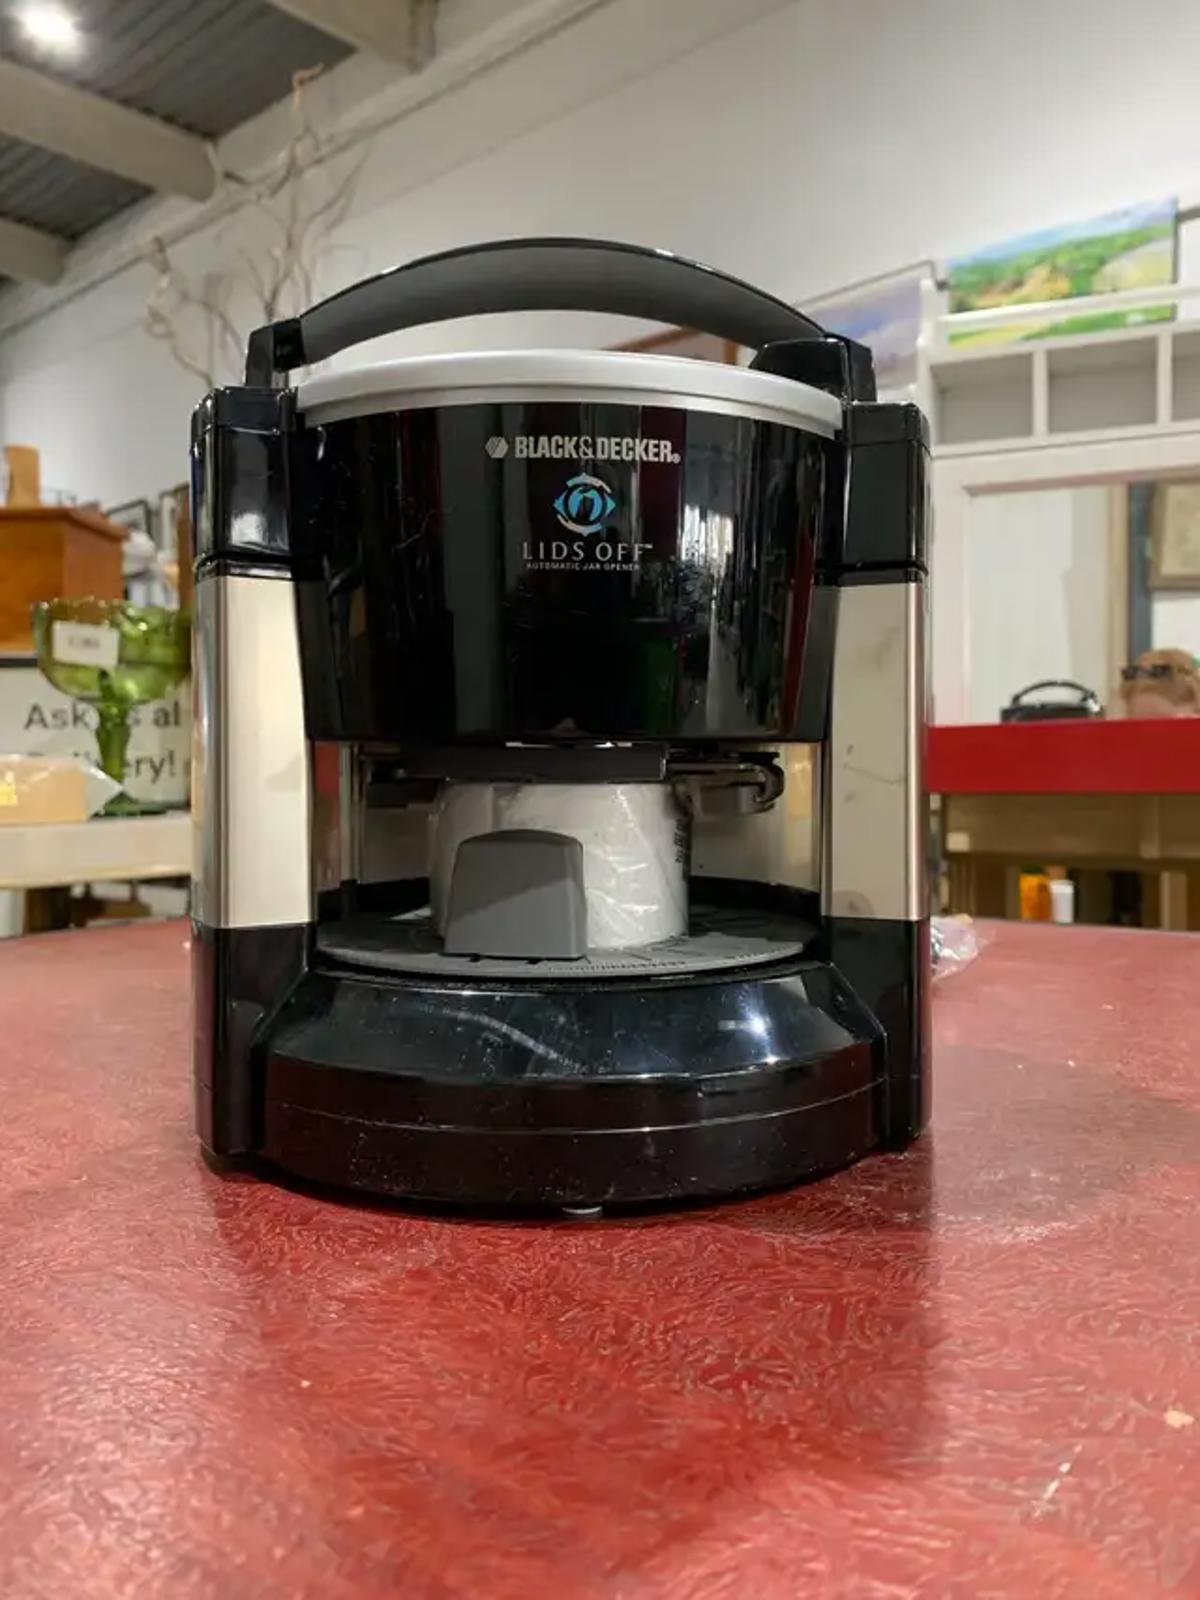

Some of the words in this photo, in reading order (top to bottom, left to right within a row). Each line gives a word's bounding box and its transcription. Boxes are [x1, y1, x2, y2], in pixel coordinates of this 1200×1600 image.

[522, 541, 585, 560] LIDS
[526, 561, 580, 571] AUTOMATIC
[582, 562, 601, 571] JAR
[603, 563, 640, 572] OPENER
[24, 701, 90, 730] Ask
